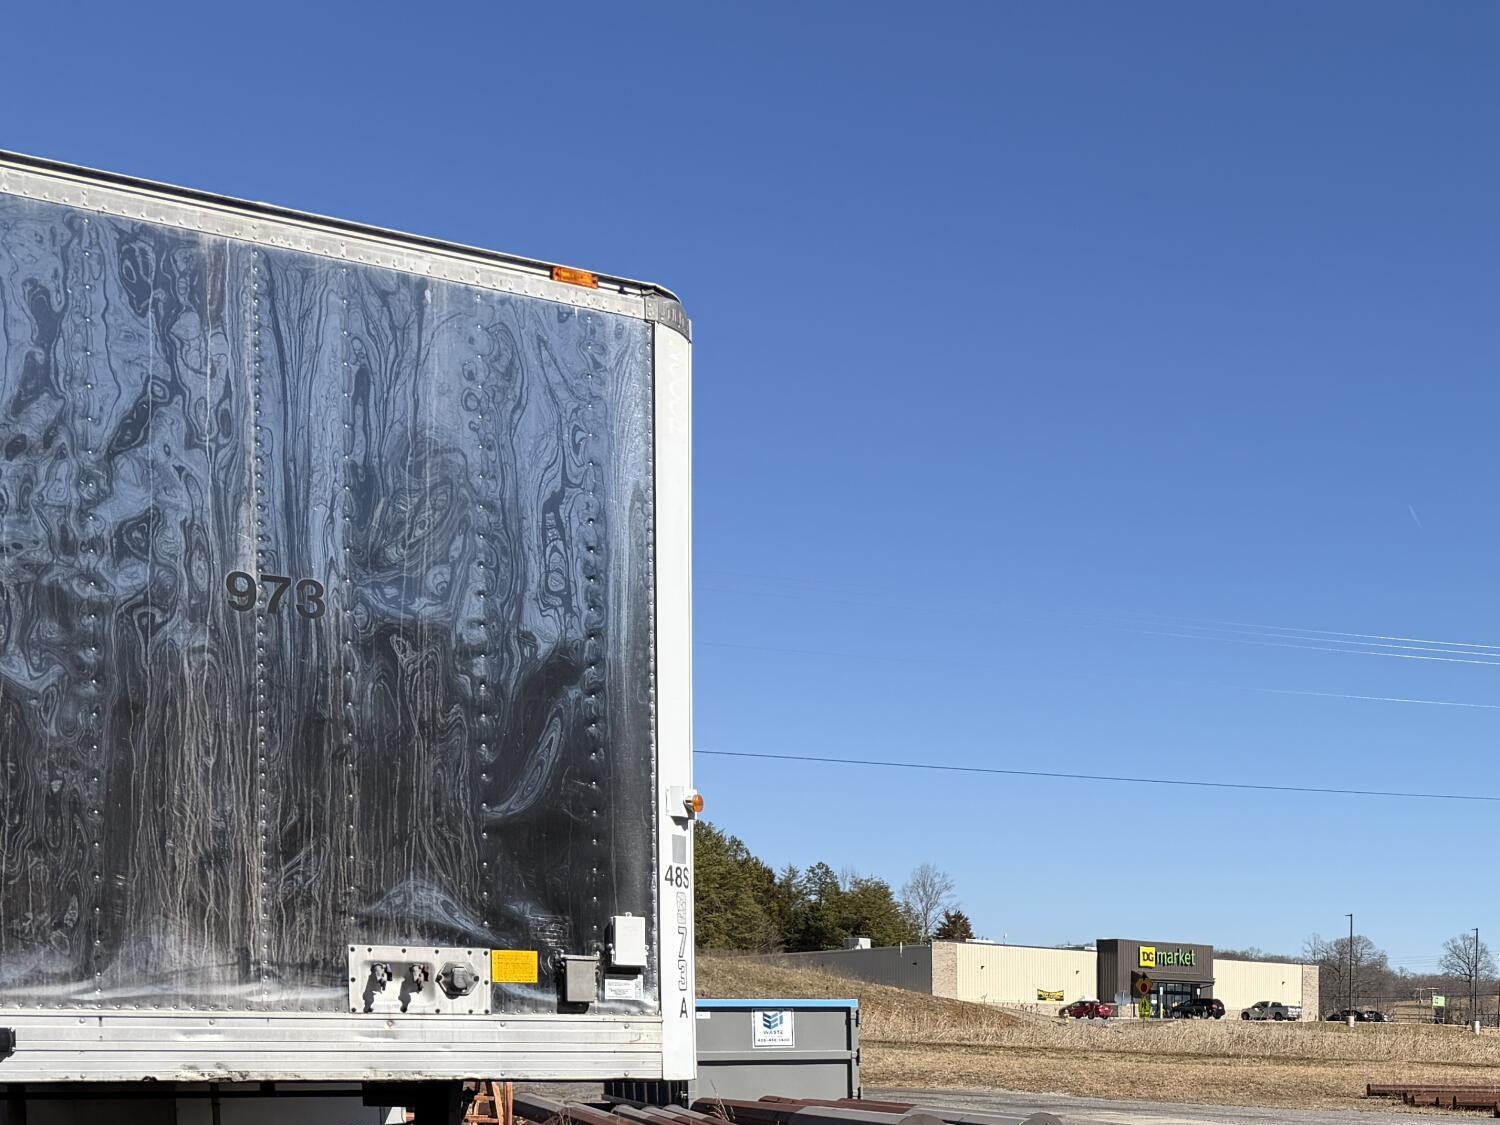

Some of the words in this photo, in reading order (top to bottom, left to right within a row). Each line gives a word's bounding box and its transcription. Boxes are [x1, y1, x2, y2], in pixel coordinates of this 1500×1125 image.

[225, 571, 326, 619] 973
[664, 864, 690, 889] 48S
[1157, 948, 1196, 966] market
[679, 997, 689, 1019] A
